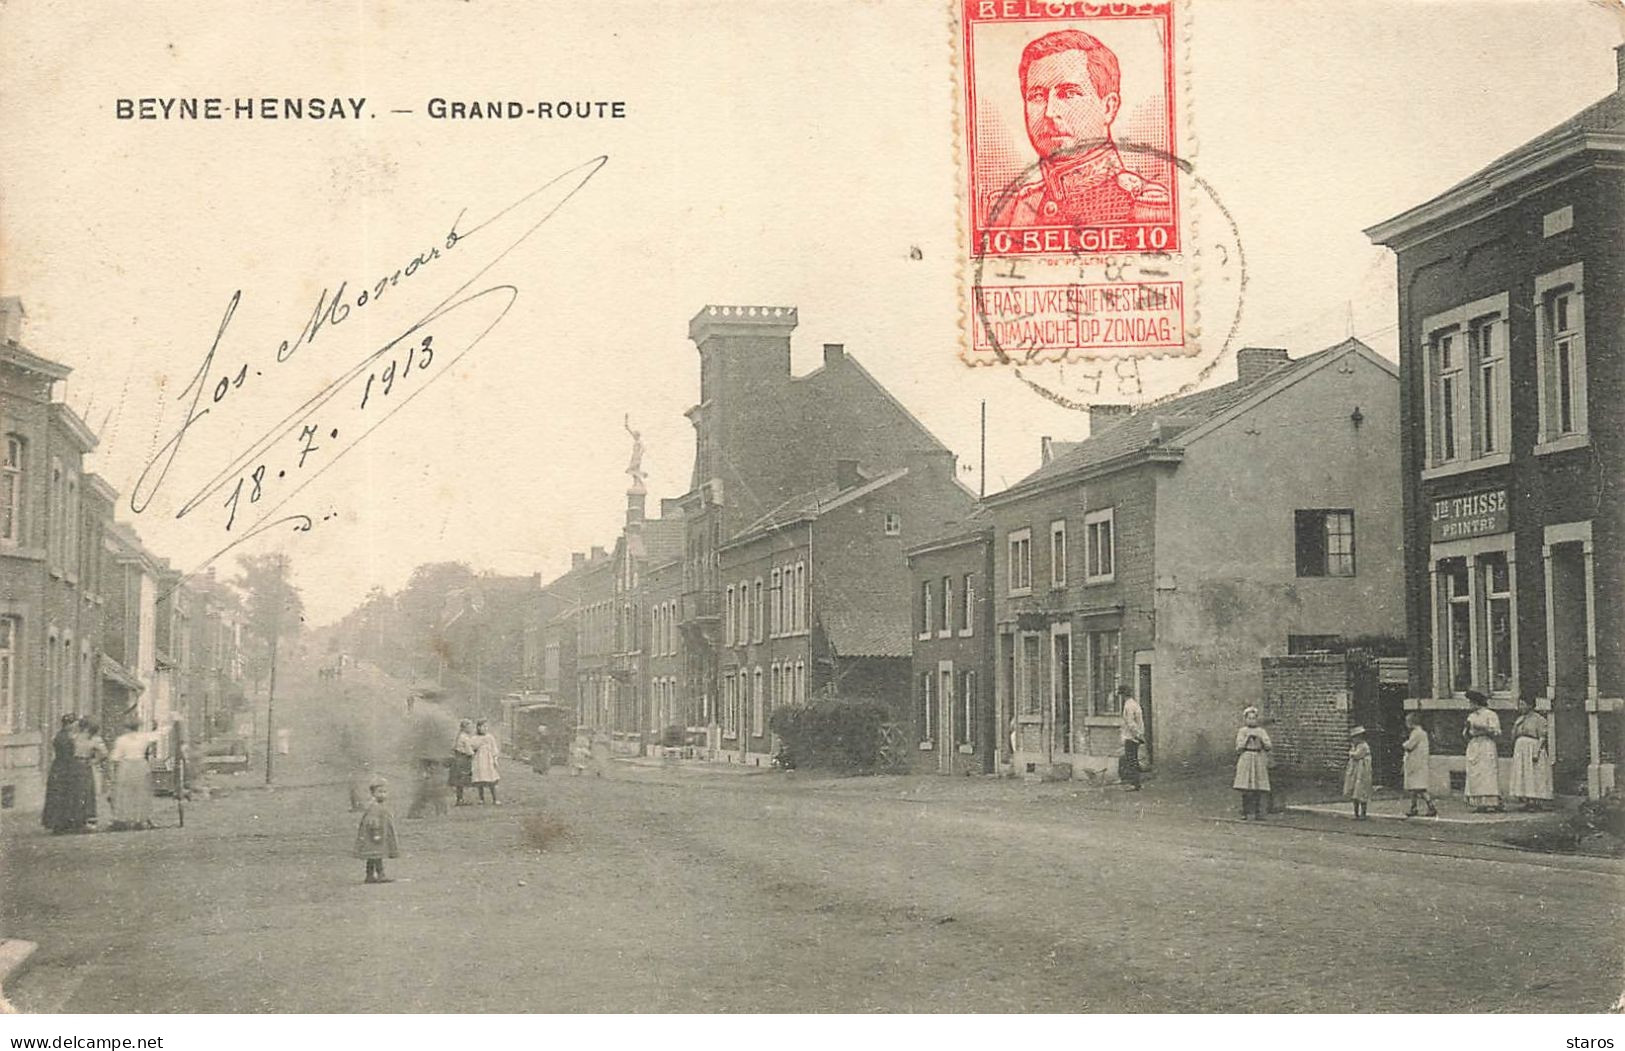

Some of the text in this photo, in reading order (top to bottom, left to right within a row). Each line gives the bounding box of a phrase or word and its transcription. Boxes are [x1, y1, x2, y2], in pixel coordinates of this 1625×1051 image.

[117, 98, 375, 119] BEYNE-HENSAY.
[428, 98, 625, 118] GRAND-ROUTE
[1023, 230, 1127, 252] BELGIE
[1135, 227, 1168, 249] 10
[1081, 319, 1100, 342] OP
[360, 335, 434, 409] 1913
[1453, 491, 1506, 518] THISSE
[1443, 517, 1496, 536] PEINTRE
